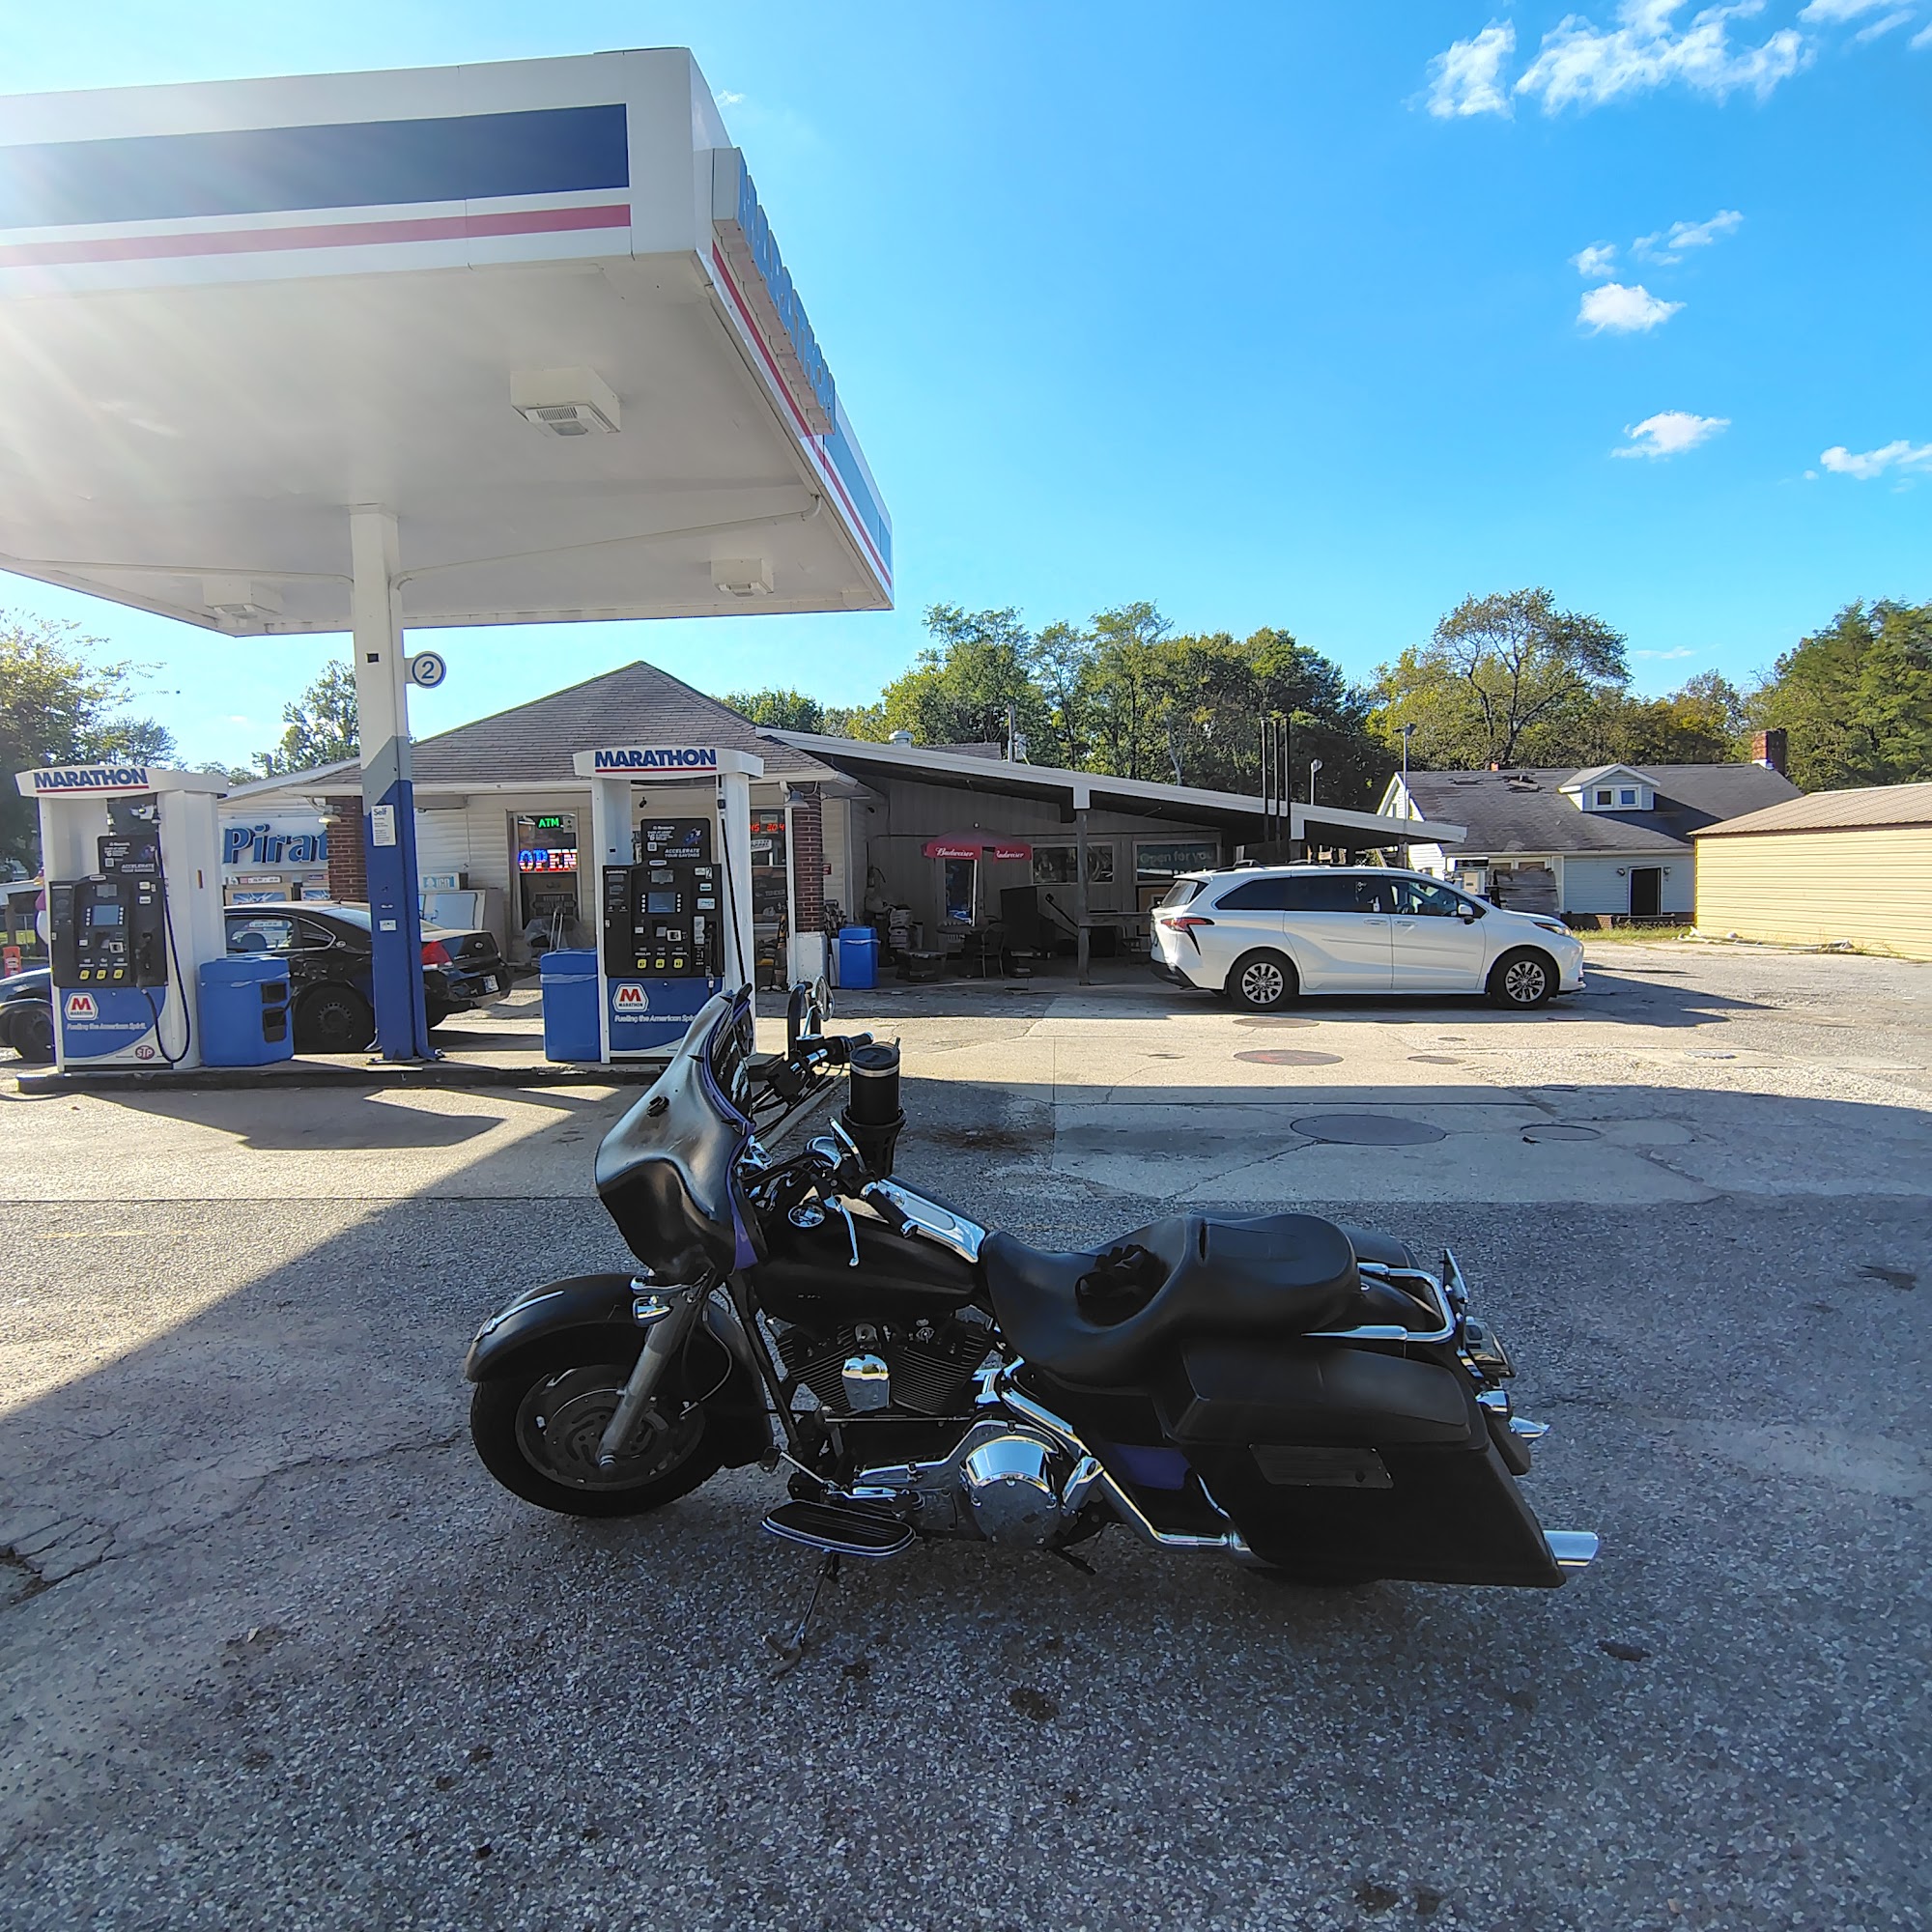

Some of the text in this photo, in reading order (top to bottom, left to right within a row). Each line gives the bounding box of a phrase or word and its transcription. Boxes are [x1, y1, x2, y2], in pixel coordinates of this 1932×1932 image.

[421, 660, 435, 679] 2
[594, 749, 718, 768] MARATHON
[34, 768, 149, 788] MARATHON
[374, 808, 387, 816] Self
[538, 817, 560, 828] ATM
[935, 846, 974, 857] Budweiser
[518, 848, 578, 872] OPEN
[1140, 850, 1214, 867] Open for you
[619, 988, 641, 1002] M
[71, 997, 92, 1010] M
[614, 1014, 638, 1023] Fueling
[136, 1046, 153, 1058] STP
